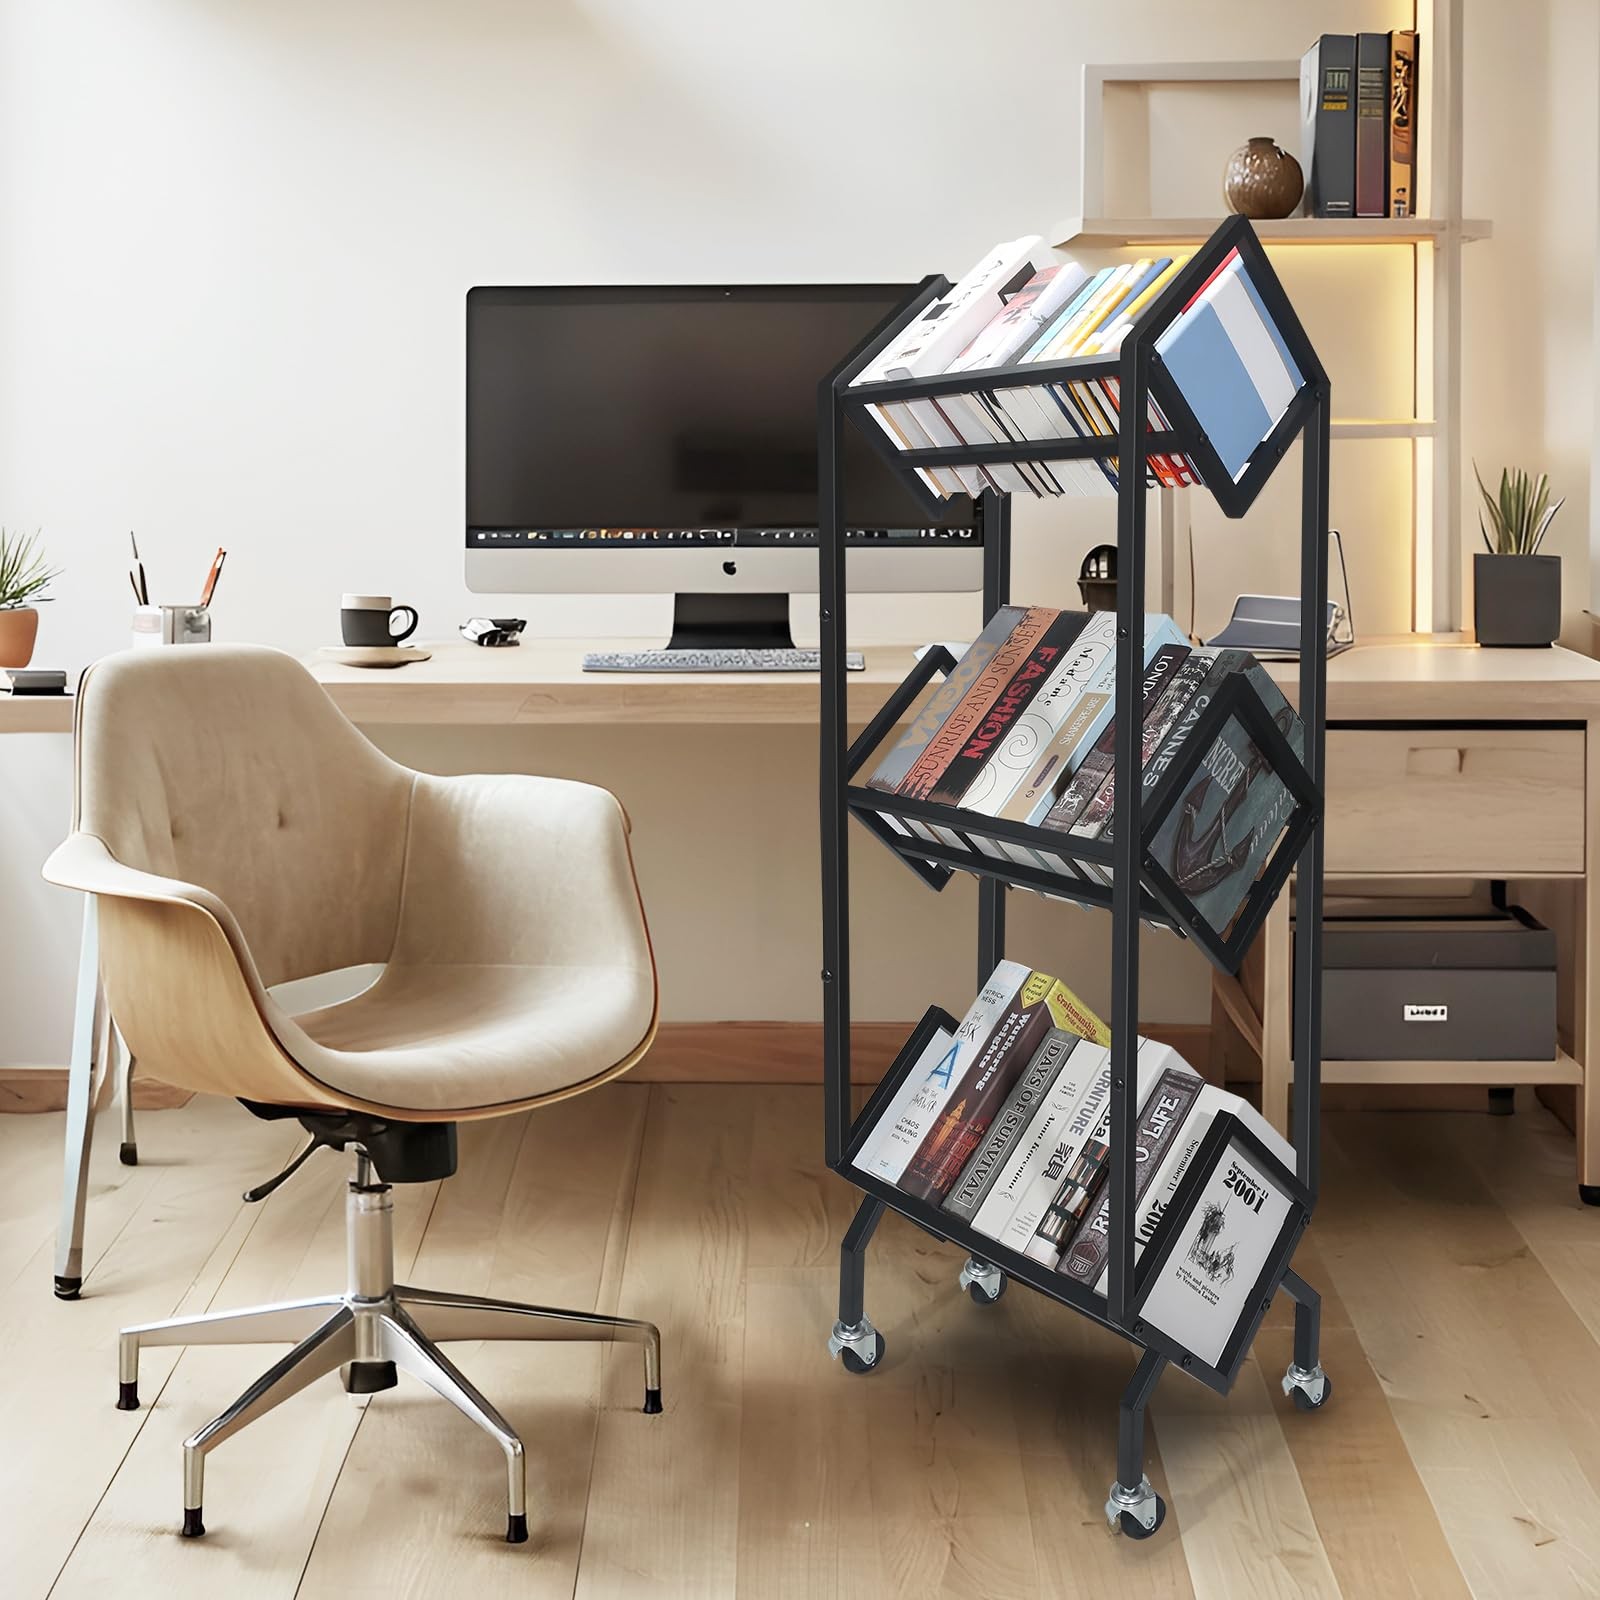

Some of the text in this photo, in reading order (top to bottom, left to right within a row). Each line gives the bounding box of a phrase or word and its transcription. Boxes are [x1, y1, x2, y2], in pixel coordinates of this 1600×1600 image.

[1044, 647, 1093, 706] Madame
[914, 619, 1042, 783] SUNRISE AND SUNSET
[962, 646, 1059, 760] FASHION
[1060, 696, 1101, 745] SHAKESPEARE
[1143, 695, 1210, 787] CANNES
[959, 1021, 981, 1042] ASK
[1056, 993, 1097, 1037] Craftsmanship
[975, 1013, 1031, 1092] Wuthering
[978, 1012, 1019, 1068] Heights
[960, 1044, 1061, 1200] DAYS OF SURVIVAL
[1069, 1062, 1110, 1136] URNITURE
[1142, 1095, 1180, 1140] LIFE
[894, 1124, 918, 1138] WALKING
[901, 1117, 920, 1130] CHAOS
[1172, 1139, 1200, 1181] September
[1231, 1160, 1261, 1192] September
[1222, 1169, 1265, 1215] 2001
[1179, 1266, 1220, 1301] words and pictures
[1181, 1275, 1201, 1294] Veronica
